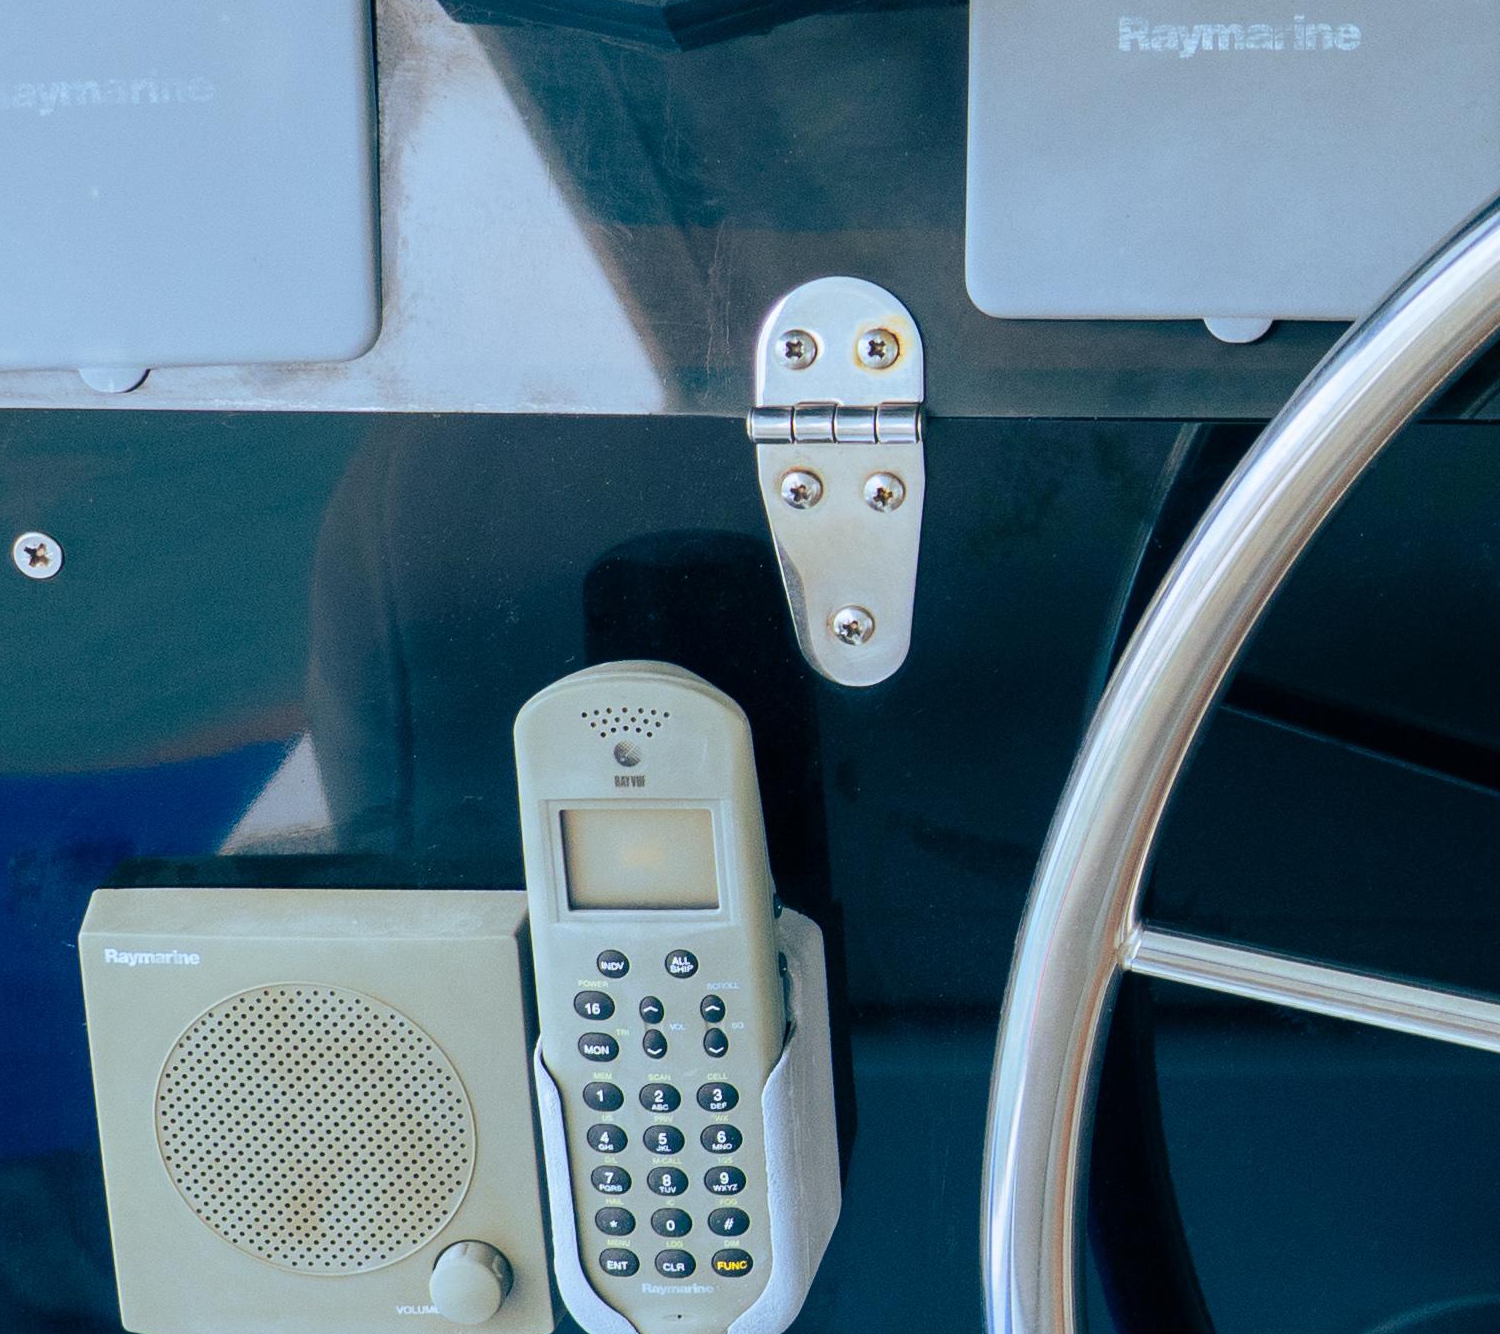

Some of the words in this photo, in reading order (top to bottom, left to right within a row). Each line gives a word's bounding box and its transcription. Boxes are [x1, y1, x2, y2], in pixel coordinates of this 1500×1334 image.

[104, 948, 200, 966] Raymarine
[672, 956, 690, 965] ALL
[601, 961, 625, 970] INDV
[670, 964, 694, 973] SHIP
[584, 1003, 601, 1015] 16
[584, 1044, 610, 1055] MON
[596, 1089, 604, 1102] 1
[654, 1089, 664, 1103] 2
[712, 1088, 723, 1102] 3
[709, 1102, 728, 1110] DEF
[599, 1131, 610, 1143] 4
[658, 1132, 668, 1145] 5
[716, 1131, 727, 1143] 6
[656, 1144, 671, 1152] JKL
[712, 1142, 733, 1150] MNO
[604, 1172, 614, 1184] 7
[661, 1174, 672, 1186] 8
[719, 1172, 729, 1184] 9
[659, 1186, 677, 1194] TUV
[713, 1183, 738, 1192] WXYZ
[665, 1219, 675, 1231] 0
[606, 1260, 628, 1271] ENT
[662, 1262, 685, 1272] CLR
[717, 1260, 748, 1271] FUNC
[642, 1283, 714, 1295] Raymarine
